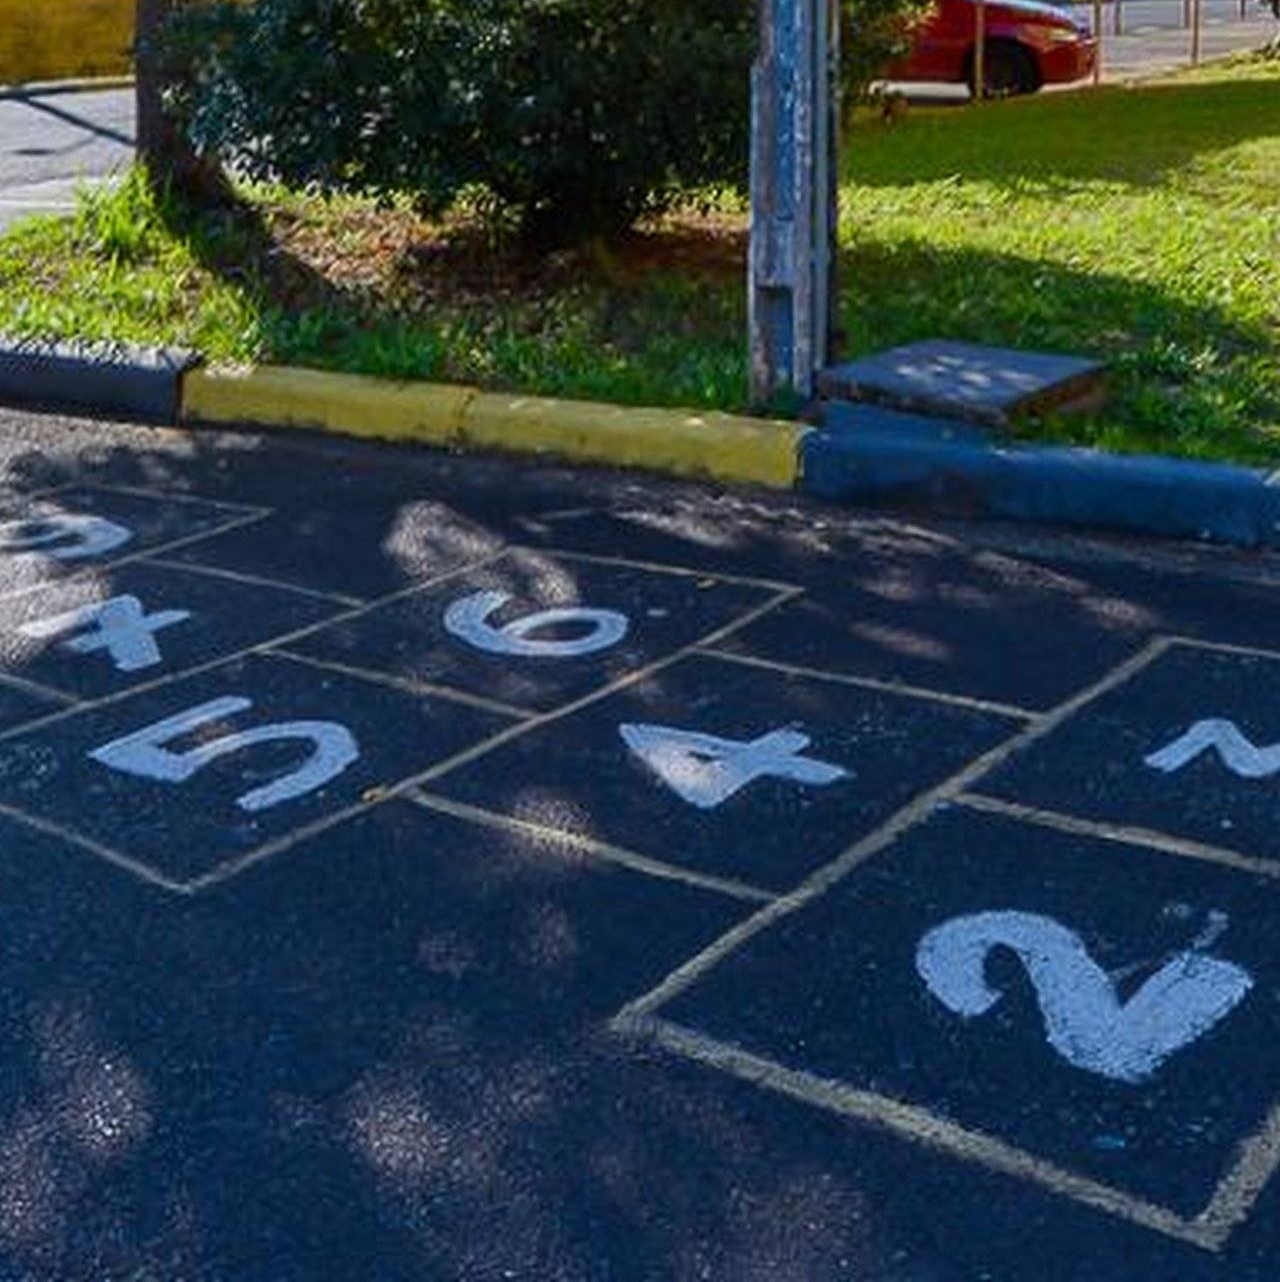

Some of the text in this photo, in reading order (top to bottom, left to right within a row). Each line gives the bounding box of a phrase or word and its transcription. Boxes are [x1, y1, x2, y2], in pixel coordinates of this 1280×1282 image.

[18, 594, 190, 671] 7
[444, 589, 628, 656] 6
[87, 696, 359, 810] 5
[619, 722, 854, 809] 4
[916, 910, 1254, 1083] 2
